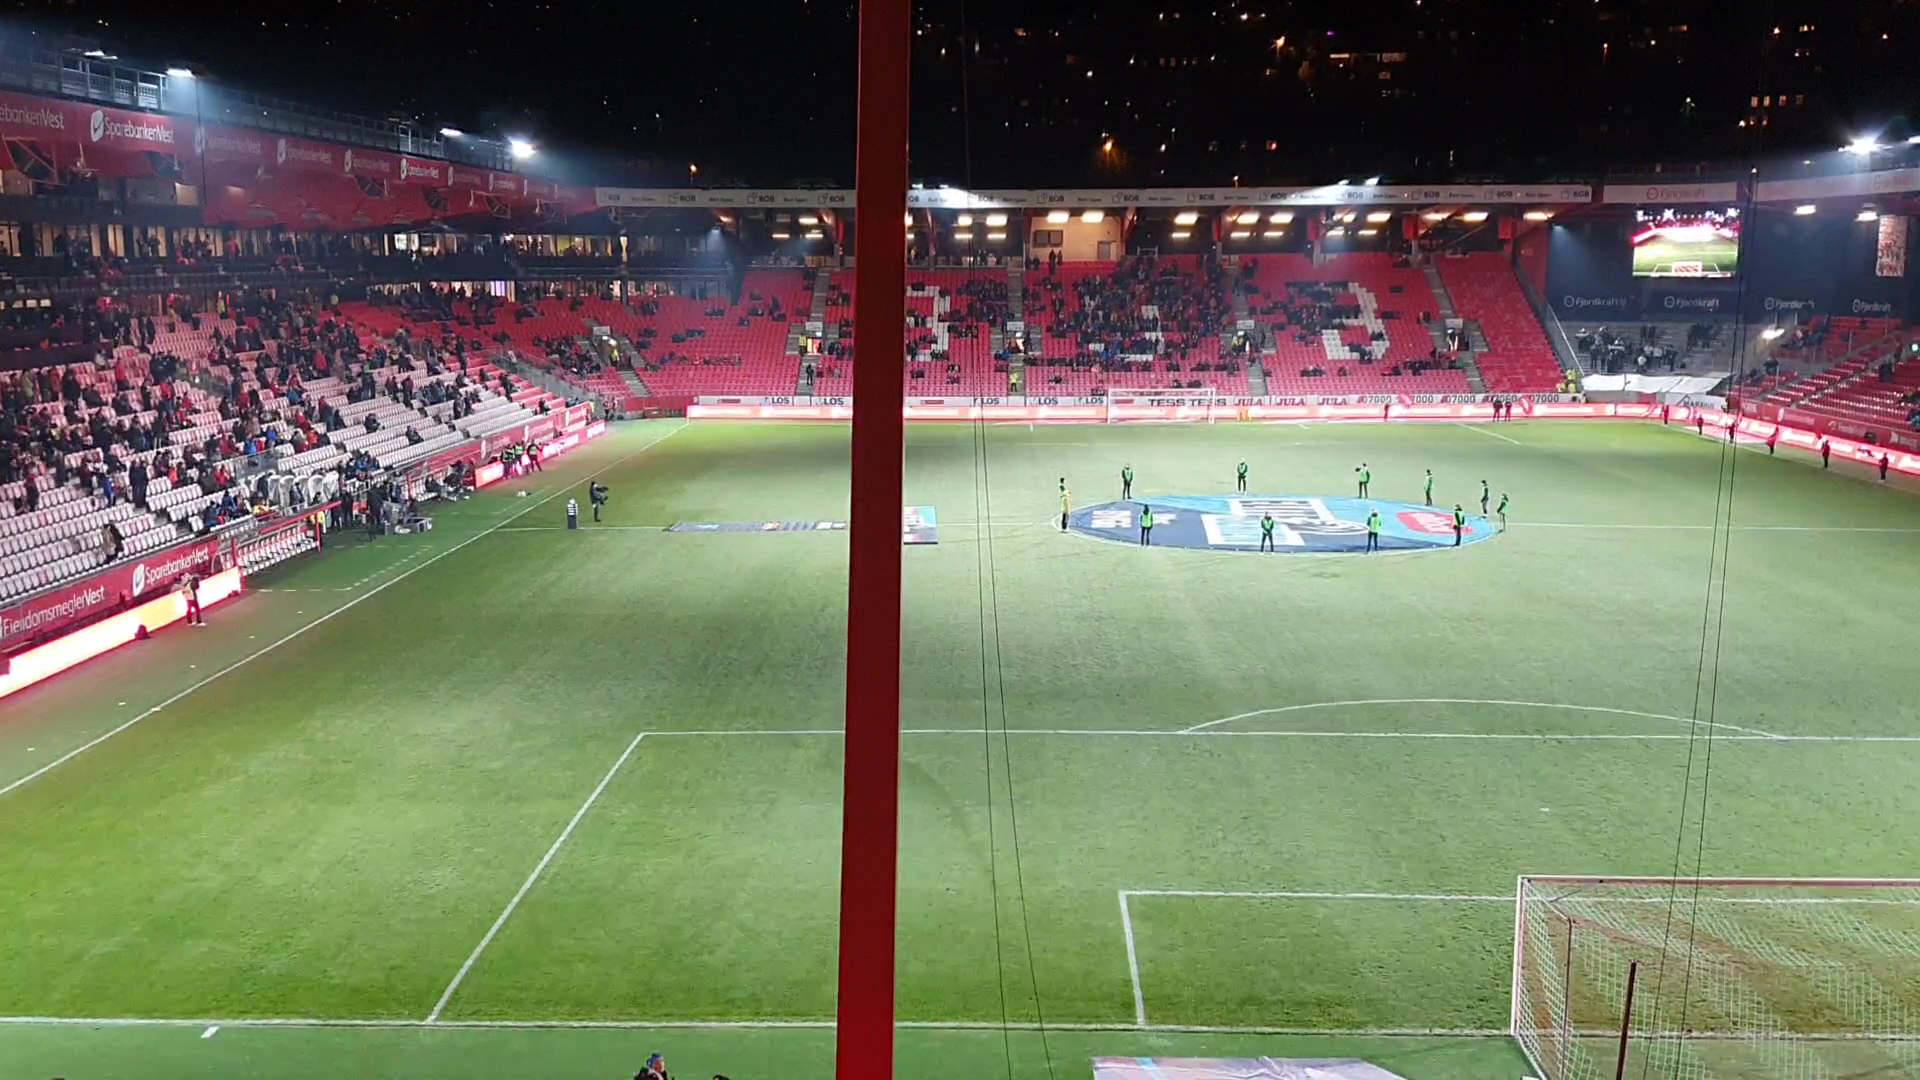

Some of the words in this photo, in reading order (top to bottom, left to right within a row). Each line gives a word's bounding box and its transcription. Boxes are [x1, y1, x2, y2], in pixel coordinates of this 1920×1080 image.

[105, 116, 175, 144] SparebankenVest
[771, 397, 790, 405] LOS
[824, 397, 844, 406] LOS
[981, 397, 1000, 405] LOS
[1038, 397, 1058, 405] LOS
[1148, 398, 1186, 407] TESS
[1235, 397, 1263, 406] JULA
[1276, 397, 1306, 406] JULA
[1318, 397, 1348, 406] JULA
[145, 546, 209, 585] SparebankenVest
